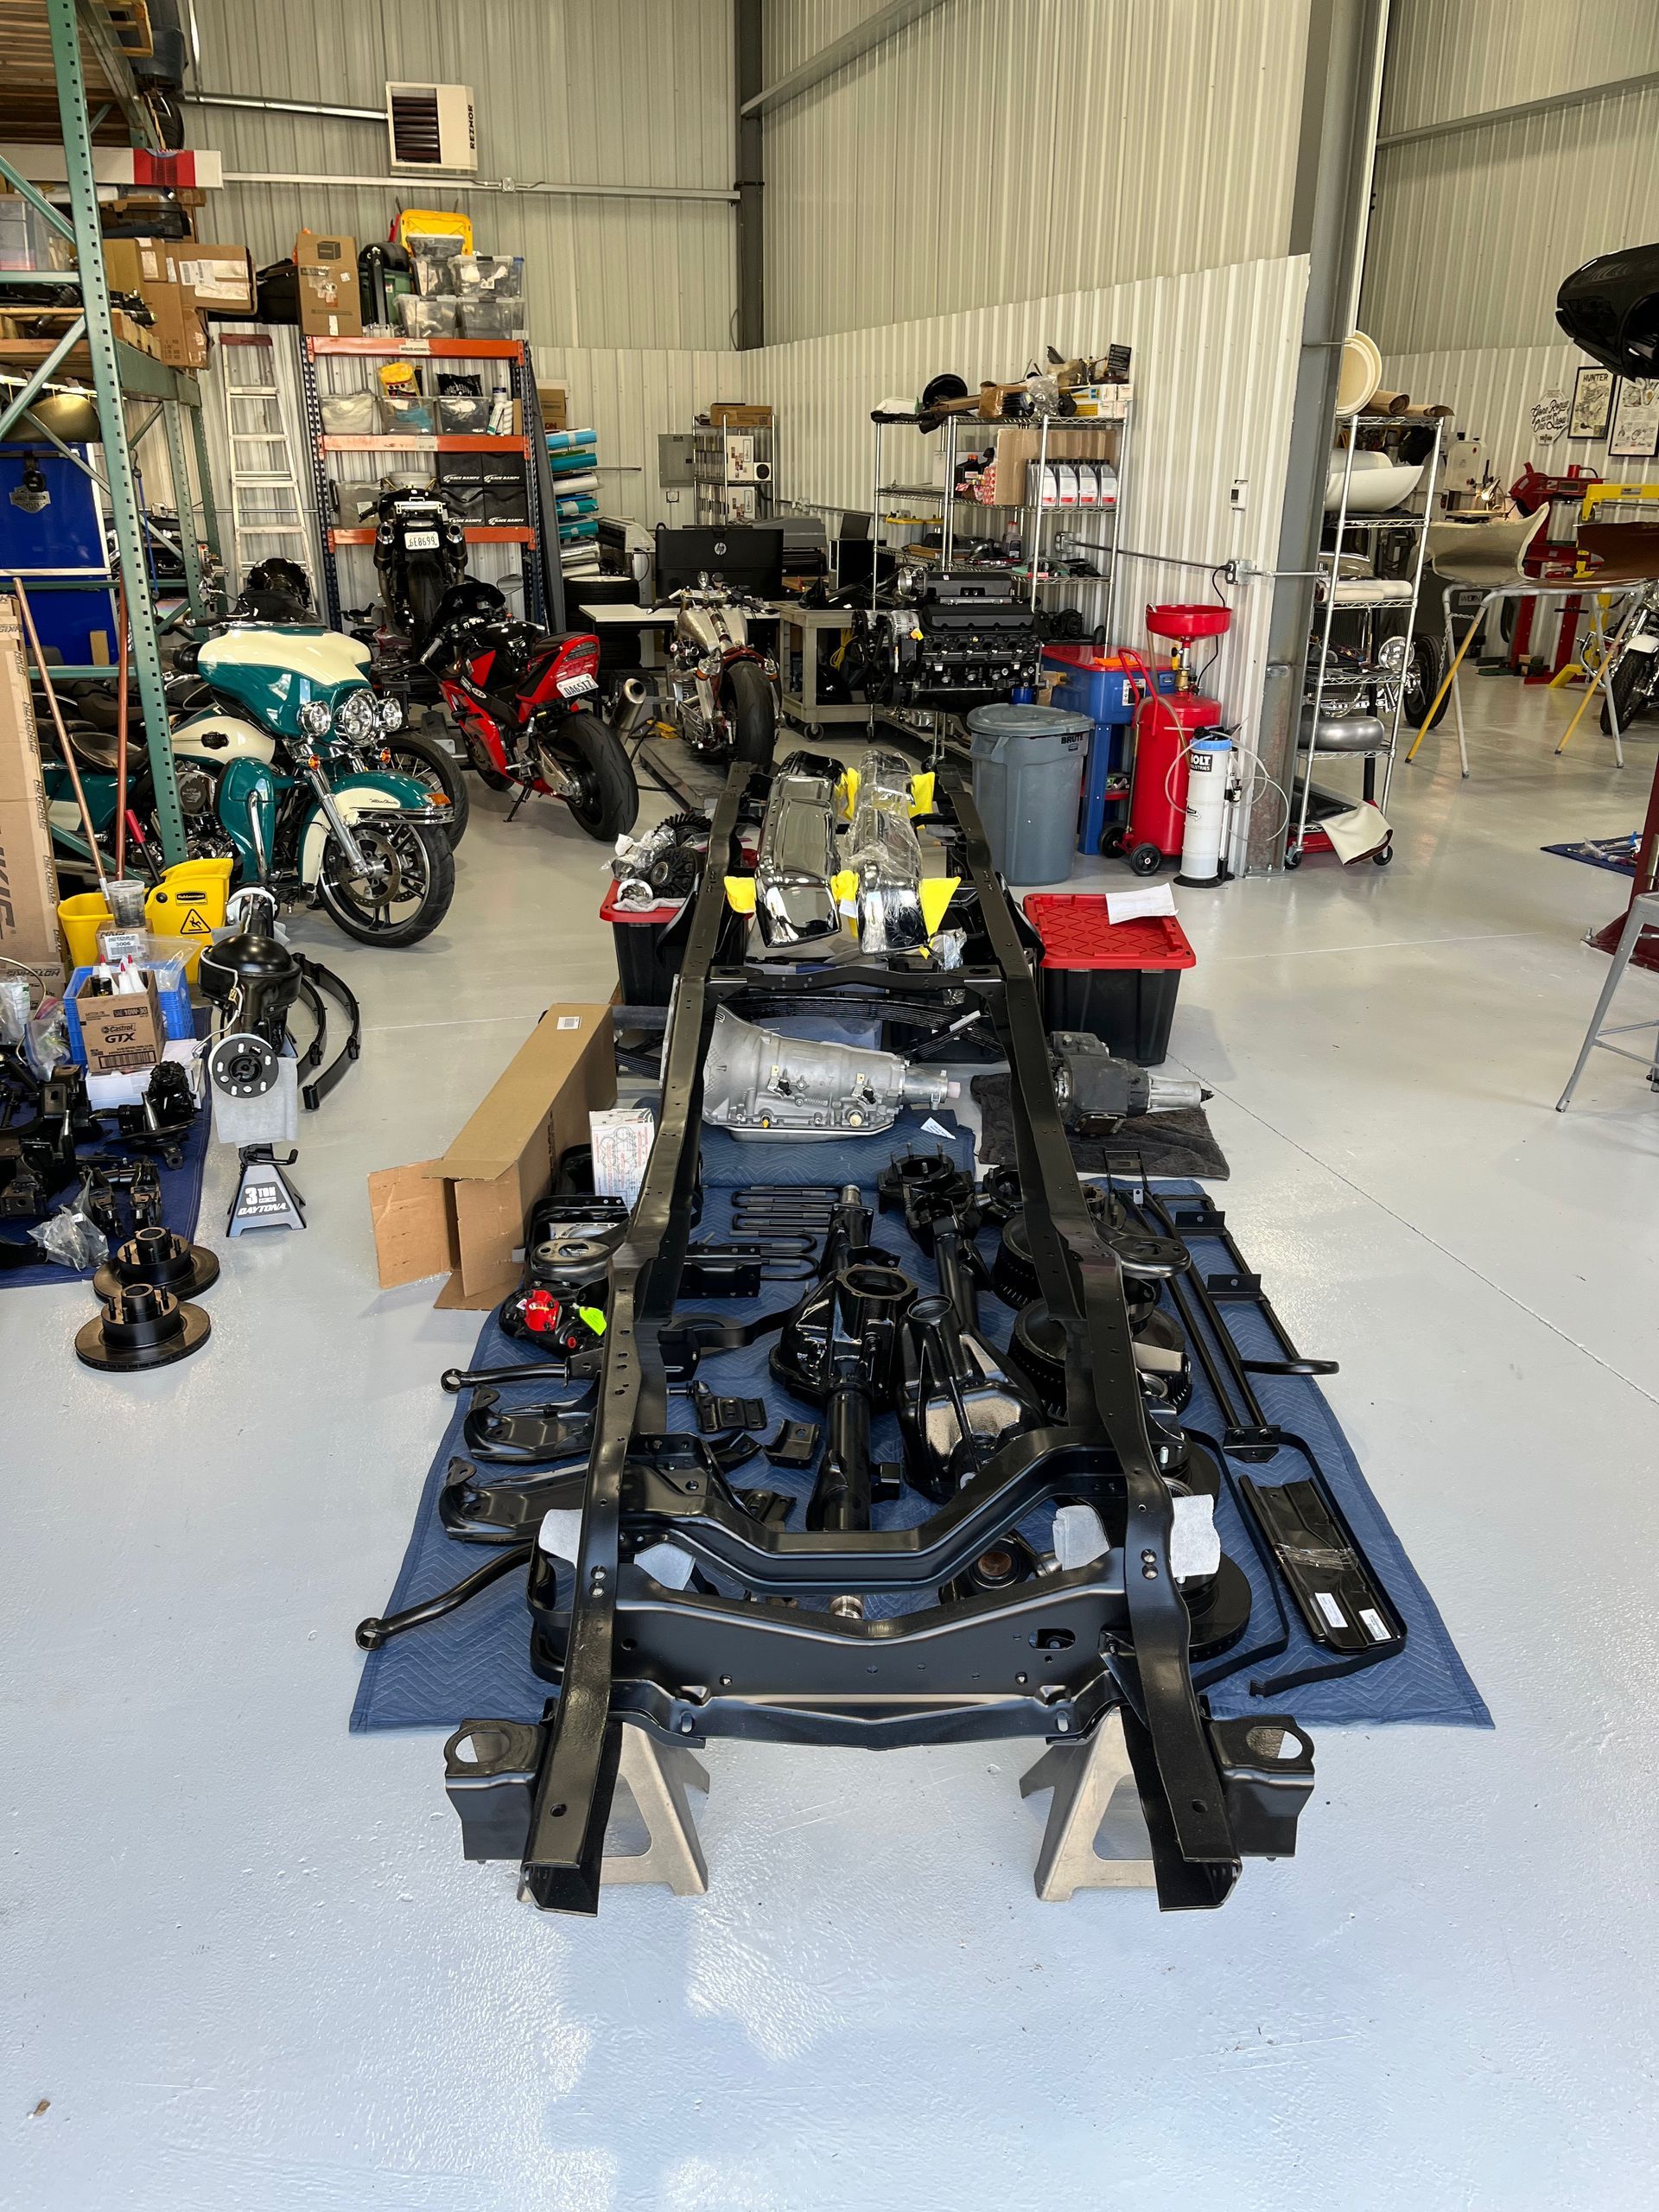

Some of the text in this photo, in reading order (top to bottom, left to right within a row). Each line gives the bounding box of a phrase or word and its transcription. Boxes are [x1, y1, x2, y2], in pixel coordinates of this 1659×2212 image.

[1583, 373, 1608, 382] HUNTER
[714, 542, 727, 556] hp
[1061, 734, 1084, 744] BRUTE
[105, 1033, 136, 1044] GTX
[245, 1186, 258, 1205] 3
[257, 1186, 276, 1198] TON
[238, 1202, 288, 1216] DAYTONA
